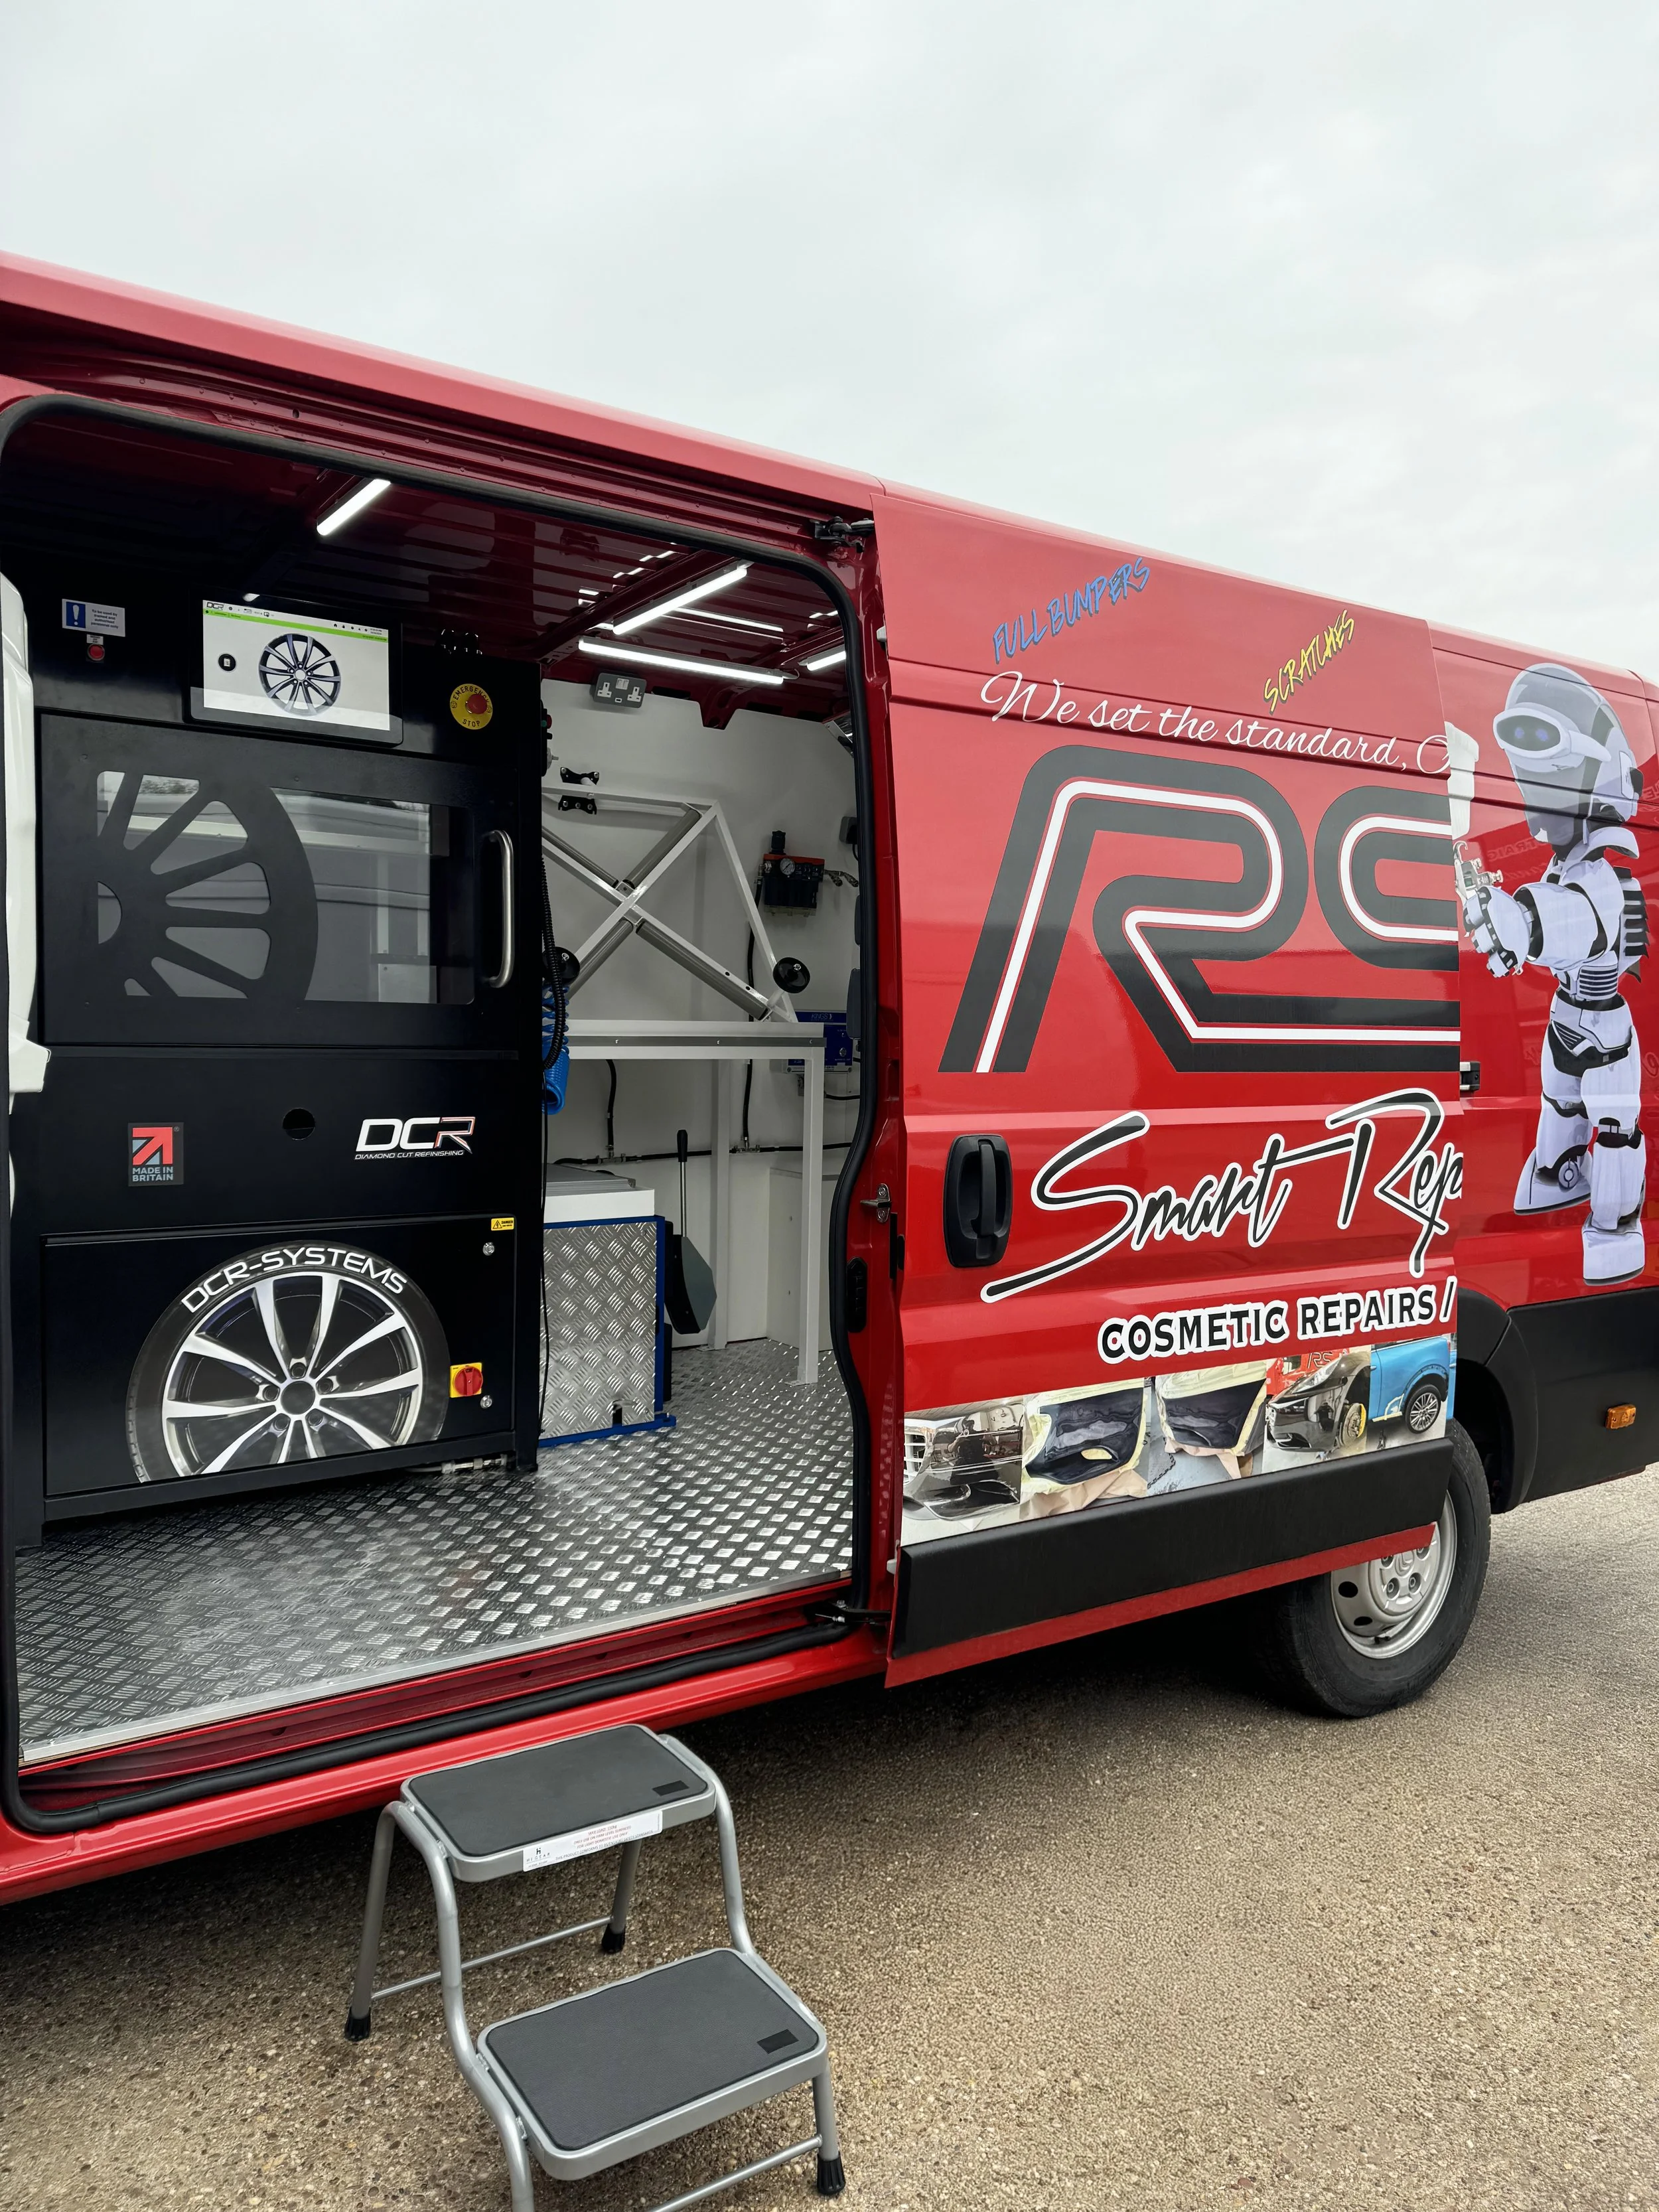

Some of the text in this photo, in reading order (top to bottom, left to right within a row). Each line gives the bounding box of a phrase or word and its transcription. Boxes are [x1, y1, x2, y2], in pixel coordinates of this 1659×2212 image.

[993, 557, 1150, 664] FULL BUMPERS
[1263, 609, 1355, 715] SCRATCHES
[463, 718, 480, 727] STOP
[980, 670, 1451, 774] We set the standard, O
[355, 1116, 476, 1154] DCR
[132, 1173, 174, 1182] BRITAIN
[981, 1110, 1355, 1304] Smart
[181, 1246, 407, 1313] DCR-SYSTEMS
[1097, 1299, 1289, 1364] COSMETIC
[1297, 1284, 1439, 1341] REPAIRS
